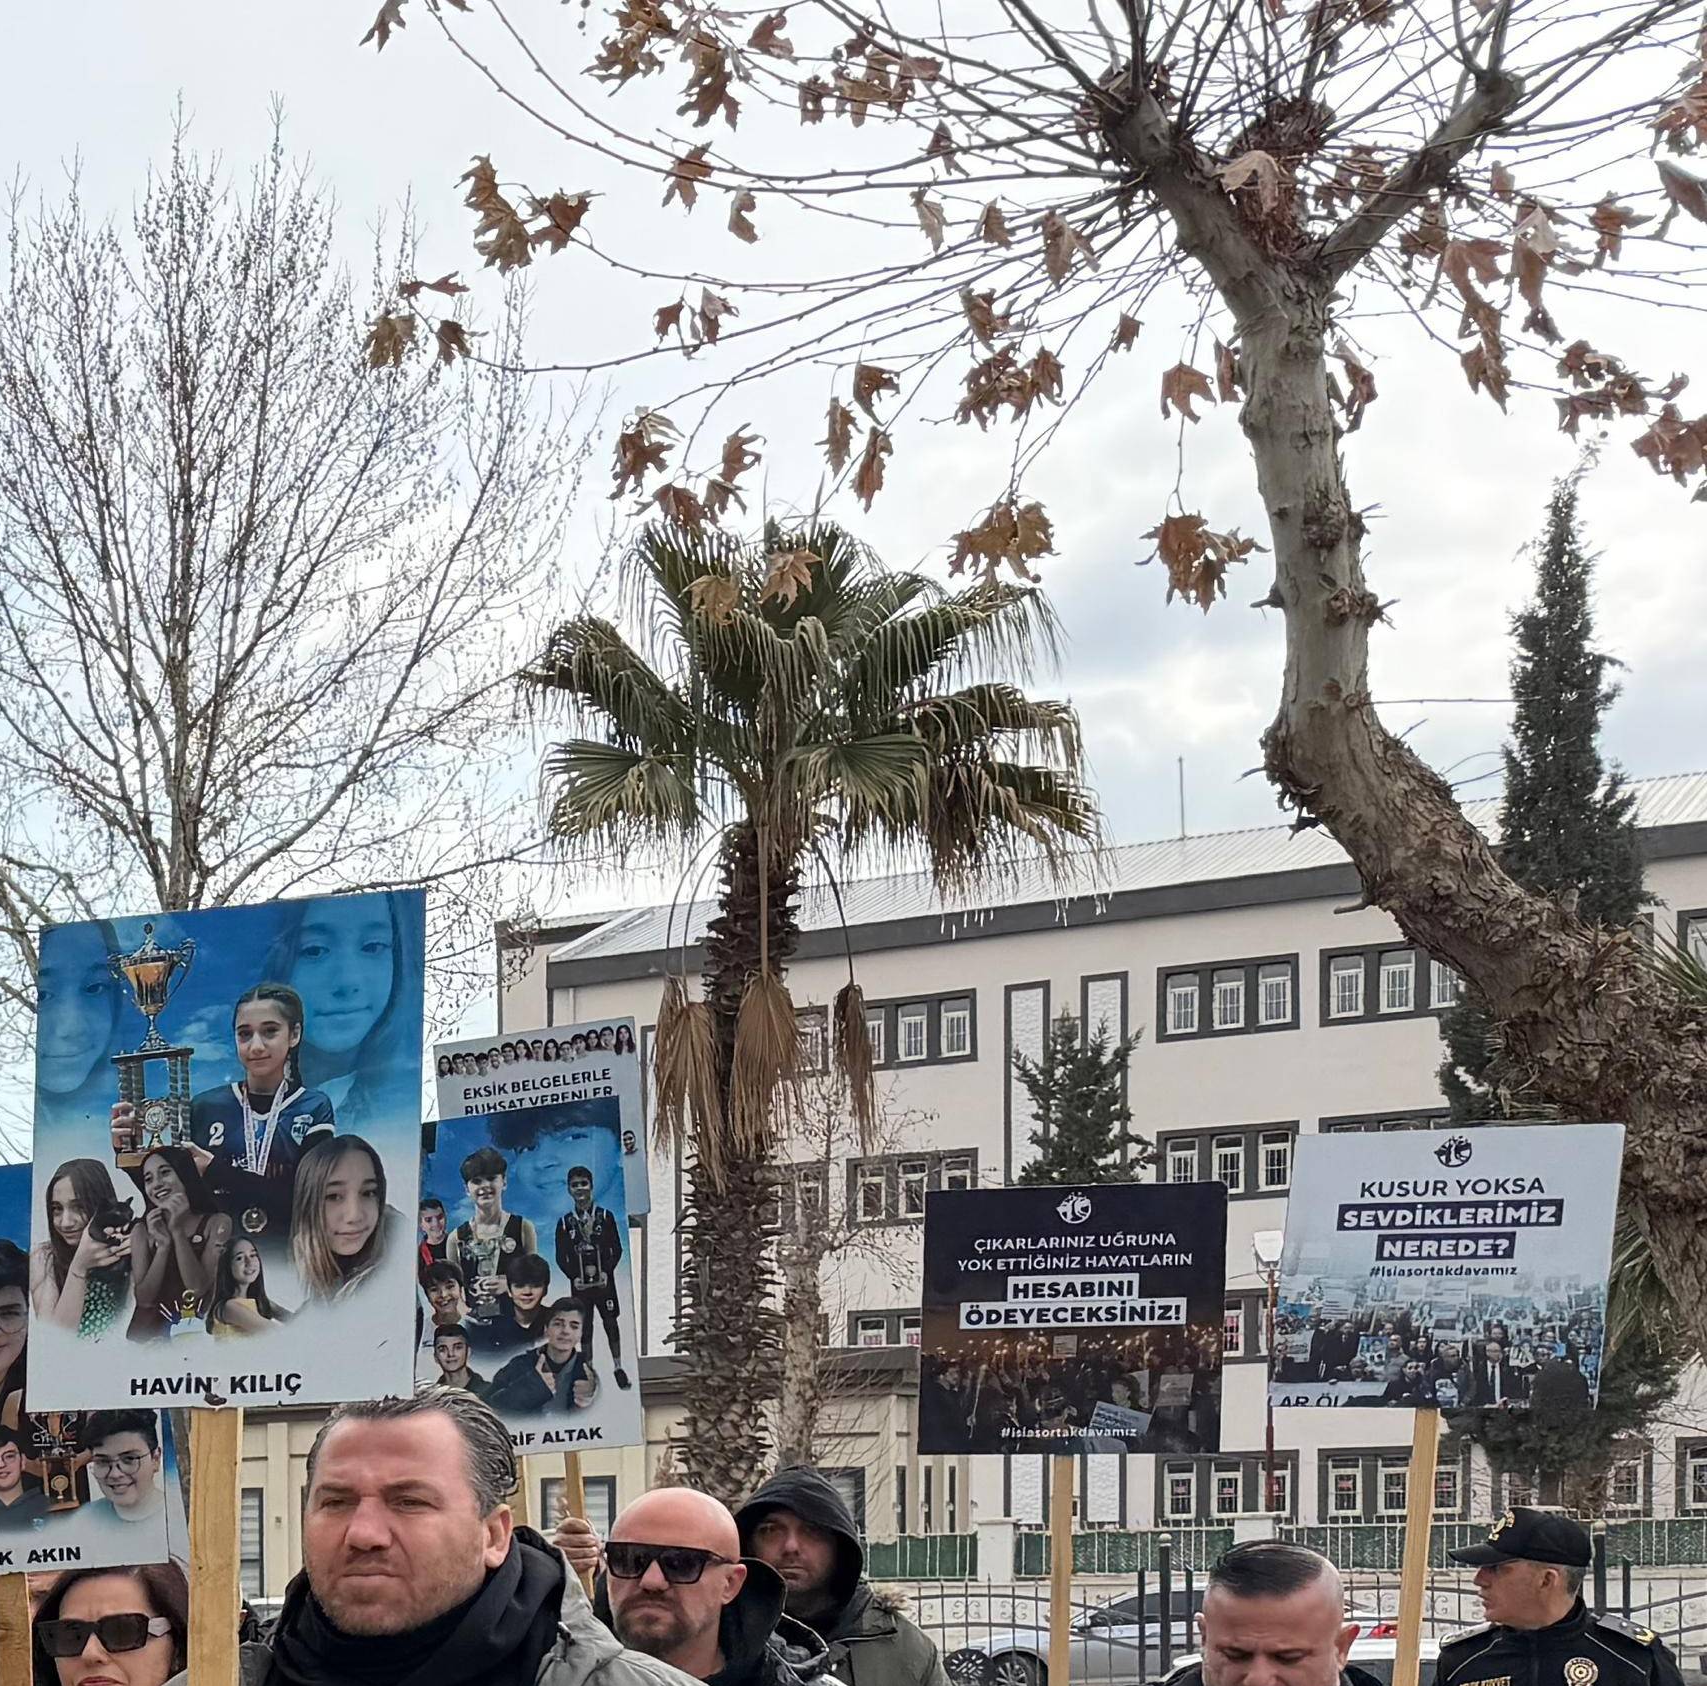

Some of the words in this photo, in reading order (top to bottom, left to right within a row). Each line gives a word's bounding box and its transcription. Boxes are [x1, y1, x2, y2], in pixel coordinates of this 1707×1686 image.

[463, 1081, 508, 1100] EKSİK
[511, 1068, 611, 1093] BELGELERLE
[209, 1121, 225, 1146] 2
[1360, 1179, 1447, 1198] KUSUR
[1455, 1177, 1545, 1196] YOKSA
[1343, 1202, 1556, 1228] SEVDİKLERİMİZ
[974, 1234, 1095, 1252] ÇIKARLARINIZ
[1100, 1230, 1176, 1247] UĞRUNA
[1382, 1238, 1510, 1258] NEREDE?
[958, 1258, 992, 1272] YOK
[996, 1254, 1080, 1271] ETTİĞİNİZ
[1085, 1253, 1193, 1267] HAYATLARIN
[1012, 1279, 1134, 1299] HESABINI
[965, 1300, 1181, 1325] ÖDEYECEKSİNİZ!
[130, 1373, 212, 1396] HAVİN
[230, 1373, 302, 1396] KILIÇ
[541, 1426, 603, 1445] ALTAK
[27, 1546, 81, 1564] AKIN
